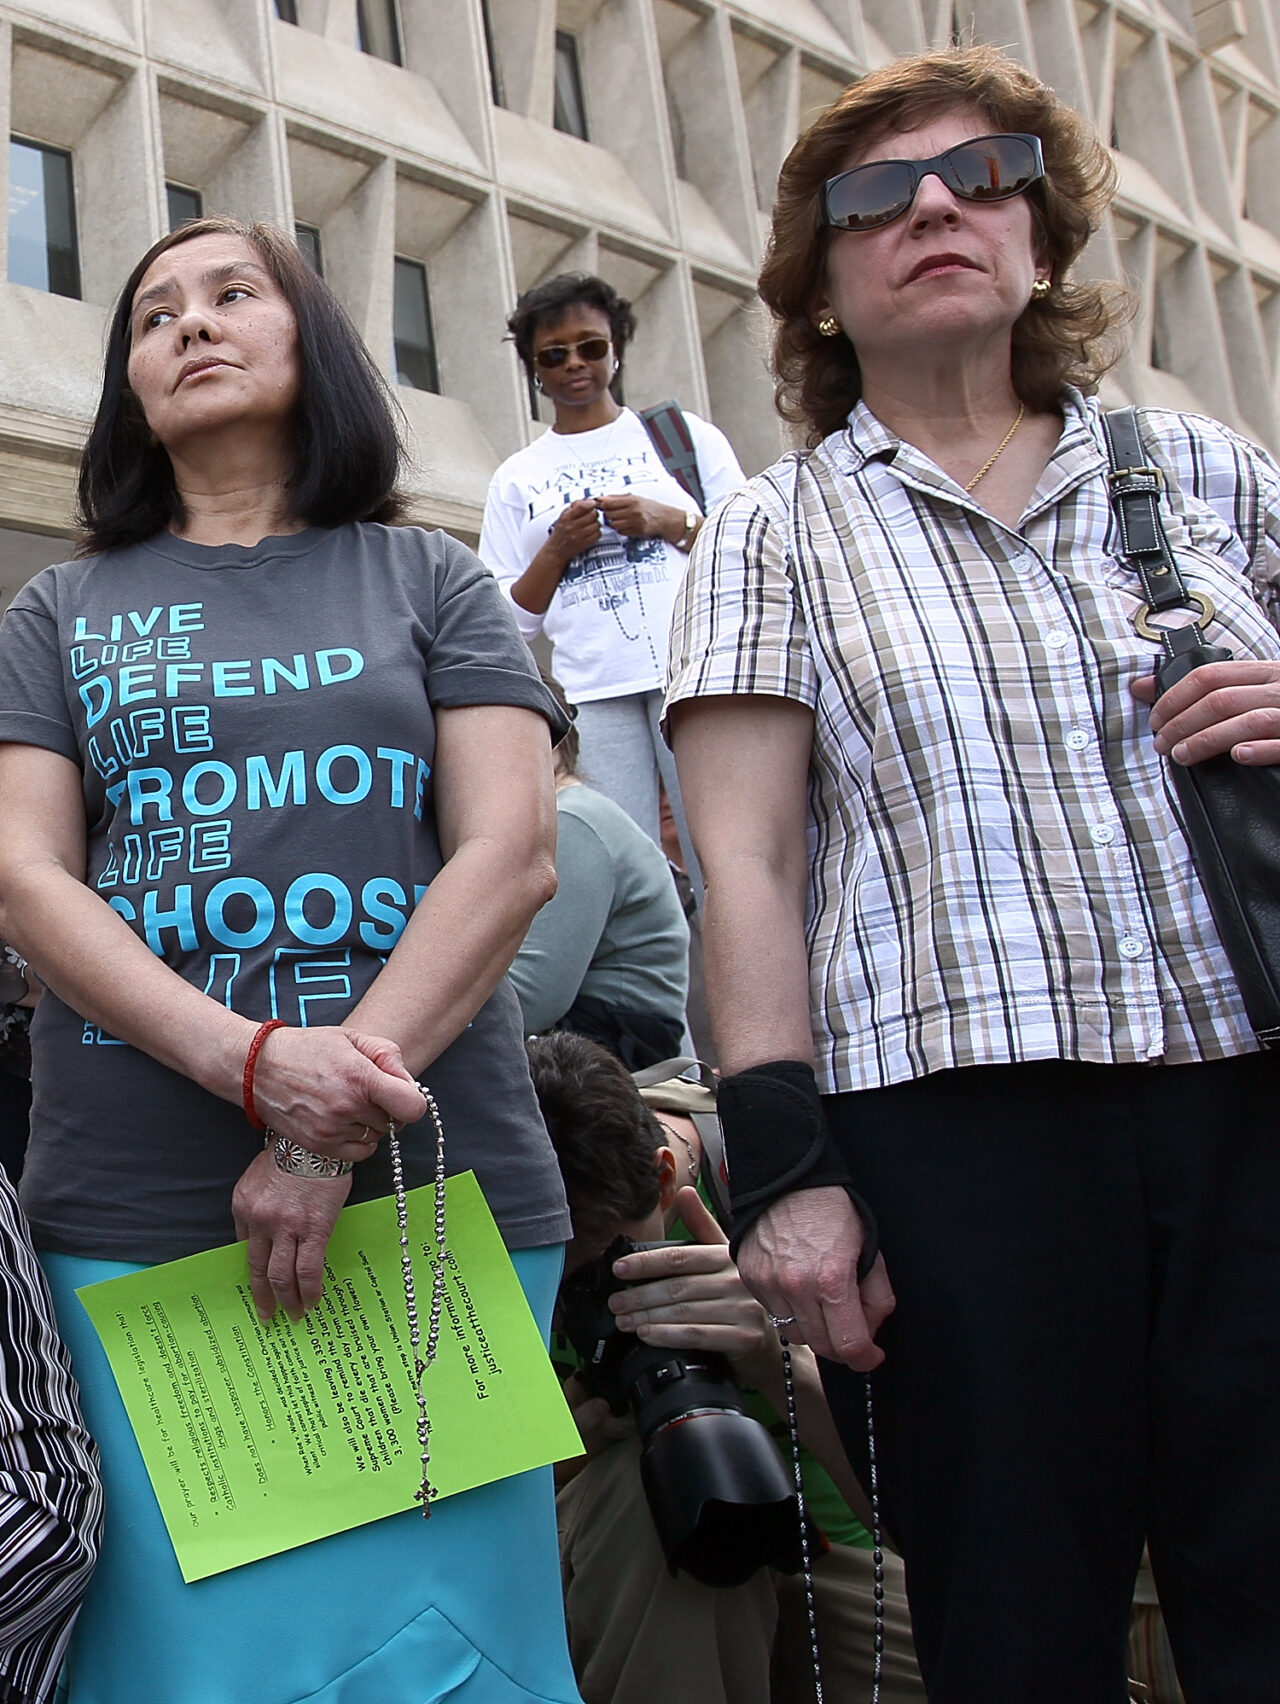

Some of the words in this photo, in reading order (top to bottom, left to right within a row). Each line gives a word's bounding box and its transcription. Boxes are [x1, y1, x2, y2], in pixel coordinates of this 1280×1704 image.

[73, 602, 205, 642] LIVE
[70, 635, 192, 680] LIFE
[78, 647, 365, 730] DEFEND
[88, 705, 213, 779] LIFE
[97, 820, 233, 889] LIFE
[108, 872, 430, 957] HOOS
[419, 1241, 434, 1257] to:
[322, 1256, 336, 1282] aborti
[318, 1285, 336, 1317] abortio
[330, 1283, 351, 1317] through
[341, 1277, 363, 1312] flowers)
[114, 1310, 128, 1329] that:
[140, 1304, 153, 1325] force
[299, 1312, 317, 1336] flowe
[313, 1305, 331, 1340] Justice
[358, 1313, 370, 1331] own
[446, 1249, 502, 1375] justiceatthecourt.com
[151, 1300, 183, 1368] abortion-causing
[261, 1323, 272, 1340] Tha
[331, 1316, 346, 1339] from
[344, 1318, 364, 1352] bruised
[125, 1331, 146, 1375] legislation
[149, 1328, 167, 1360] doesn't
[203, 1328, 226, 1373] subsidized
[310, 1335, 327, 1365] 3,330
[326, 1339, 338, 1356] the
[340, 1341, 354, 1358] day
[365, 1333, 381, 1355] your
[161, 1362, 174, 1378] and
[359, 1352, 370, 1370] are
[374, 1355, 388, 1380] bring
[461, 1344, 479, 1374] more
[180, 1371, 190, 1386] for
[323, 1367, 340, 1399] leaving
[330, 1358, 350, 1389] remind
[348, 1361, 362, 1386] every
[365, 1373, 379, 1393] that
[171, 1381, 189, 1418] freedom
[186, 1389, 198, 1405] pay
[223, 1376, 242, 1416] taxpayer
[252, 1380, 262, 1396] the
[346, 1391, 354, 1402] to
[358, 1388, 369, 1403] die
[384, 1382, 402, 1414] (Please
[474, 1378, 489, 1400] For
[142, 1377, 163, 1425] healthcare
[193, 1407, 201, 1418] to
[335, 1400, 345, 1414] be
[375, 1394, 391, 1426] women
[204, 1406, 216, 1422] and
[258, 1399, 274, 1431] Honors
[341, 1415, 353, 1434] also
[349, 1405, 365, 1430] Court
[364, 1406, 378, 1427] that
[160, 1428, 170, 1442] for
[184, 1421, 204, 1458] religious
[213, 1425, 226, 1449] drugs
[238, 1419, 251, 1441] have
[385, 1427, 402, 1456] 3,300
[166, 1445, 174, 1457] be
[198, 1421, 220, 1471] institutions
[246, 1442, 257, 1458] not
[346, 1436, 360, 1452] will
[361, 1432, 380, 1472] Supreme
[373, 1428, 392, 1465] children
[169, 1459, 181, 1473] will
[253, 1462, 266, 1484] Does
[355, 1454, 366, 1472] We
[177, 1478, 195, 1507] prayer
[199, 1461, 219, 1502] Respects
[216, 1474, 234, 1510] Catholic
[189, 1511, 199, 1526] our
